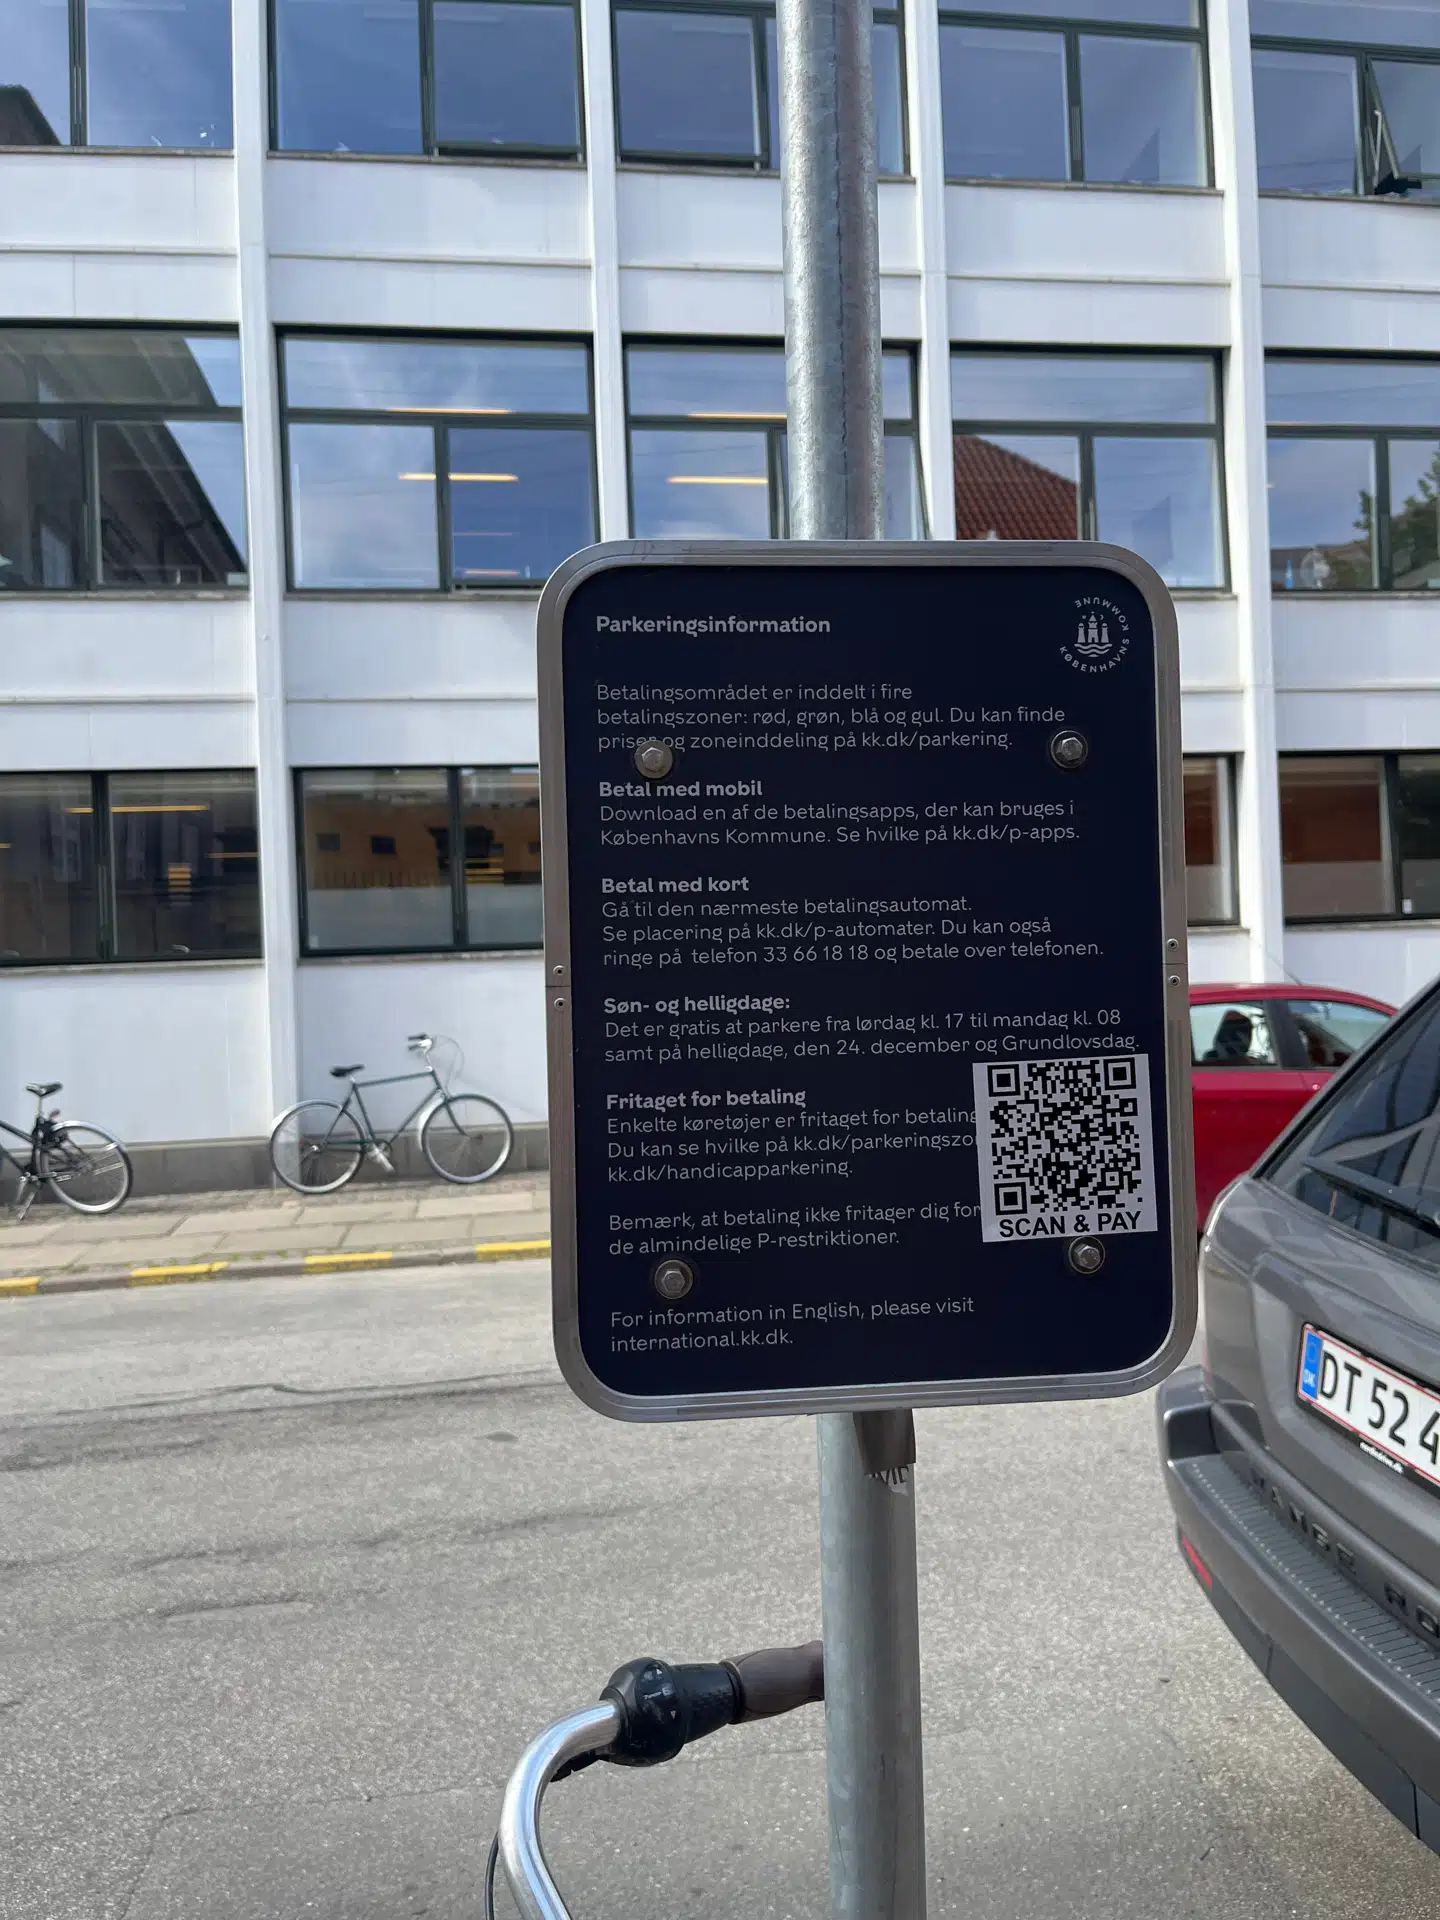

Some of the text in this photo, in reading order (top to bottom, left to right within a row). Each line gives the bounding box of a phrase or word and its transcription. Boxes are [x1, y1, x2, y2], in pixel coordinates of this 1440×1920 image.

[596, 615, 831, 638] Parkeringsinformation
[1059, 597, 1130, 673] KØBENHAVNS KOMMUNE
[597, 683, 768, 705] Betalingsområdet
[772, 688, 793, 700] er
[798, 684, 866, 700] inddelt
[880, 683, 912, 700] fire
[597, 705, 1065, 729] betalingszoner: rød, grøn, blå og gul. Du kan finde
[662, 736, 686, 753] og
[690, 732, 829, 752] zoneinddeling
[834, 731, 856, 751] på
[861, 730, 1012, 751] kk.dk/parkering.
[599, 779, 763, 797] Betal med mobil
[600, 805, 697, 821] Download
[702, 808, 726, 821] en
[731, 803, 749, 820] af
[754, 804, 778, 820] de
[784, 803, 919, 823] betalingsapps,
[924, 801, 958, 818] der
[963, 801, 994, 817] kan
[1000, 800, 1064, 820] bruges
[601, 824, 1080, 846] Københavns Kommune. Se hvilke på kk.dk/p-apps.
[601, 876, 749, 893] Betal med kort
[601, 895, 972, 918] Gå til den nærmeste betalingsautomat.
[602, 916, 1052, 945] Se placering på kk.dk/p-automater. Du kan også
[603, 939, 1104, 969] ringe på telefon 33 66 18 18 og betale over telefonen.
[603, 994, 790, 1017] Søn- og helligdage:
[605, 1008, 1121, 1040] Det er gratis at parkere fra lørdag kl. 17 til mandag kl. 08
[604, 1033, 1139, 1064] samt på helligdage, den 24. december og Grundlovsdag.
[606, 1087, 806, 1113] Fritaget for betaling
[607, 1116, 677, 1134] Enkelte
[683, 1113, 770, 1133] køretøjer
[775, 1115, 795, 1128] er
[799, 1110, 868, 1131] fritaget
[872, 1108, 900, 1125] for
[608, 1133, 977, 1158] Du kan se hvilke på kk.dk/parkeringszo
[608, 1158, 853, 1182] kk.dk/handicapparkering.
[609, 1201, 980, 1231] Bemærk, at betaling ikke fritager dig for
[999, 1211, 1141, 1238] SCAN & PAY
[608, 1229, 899, 1255] de almindelige P-restriktioner.
[611, 1296, 974, 1328] For information in English, please visit
[611, 1328, 793, 1352] international.kk.dk.
[1320, 1350, 1362, 1413] DT
[1368, 1378, 1406, 1447] 52
